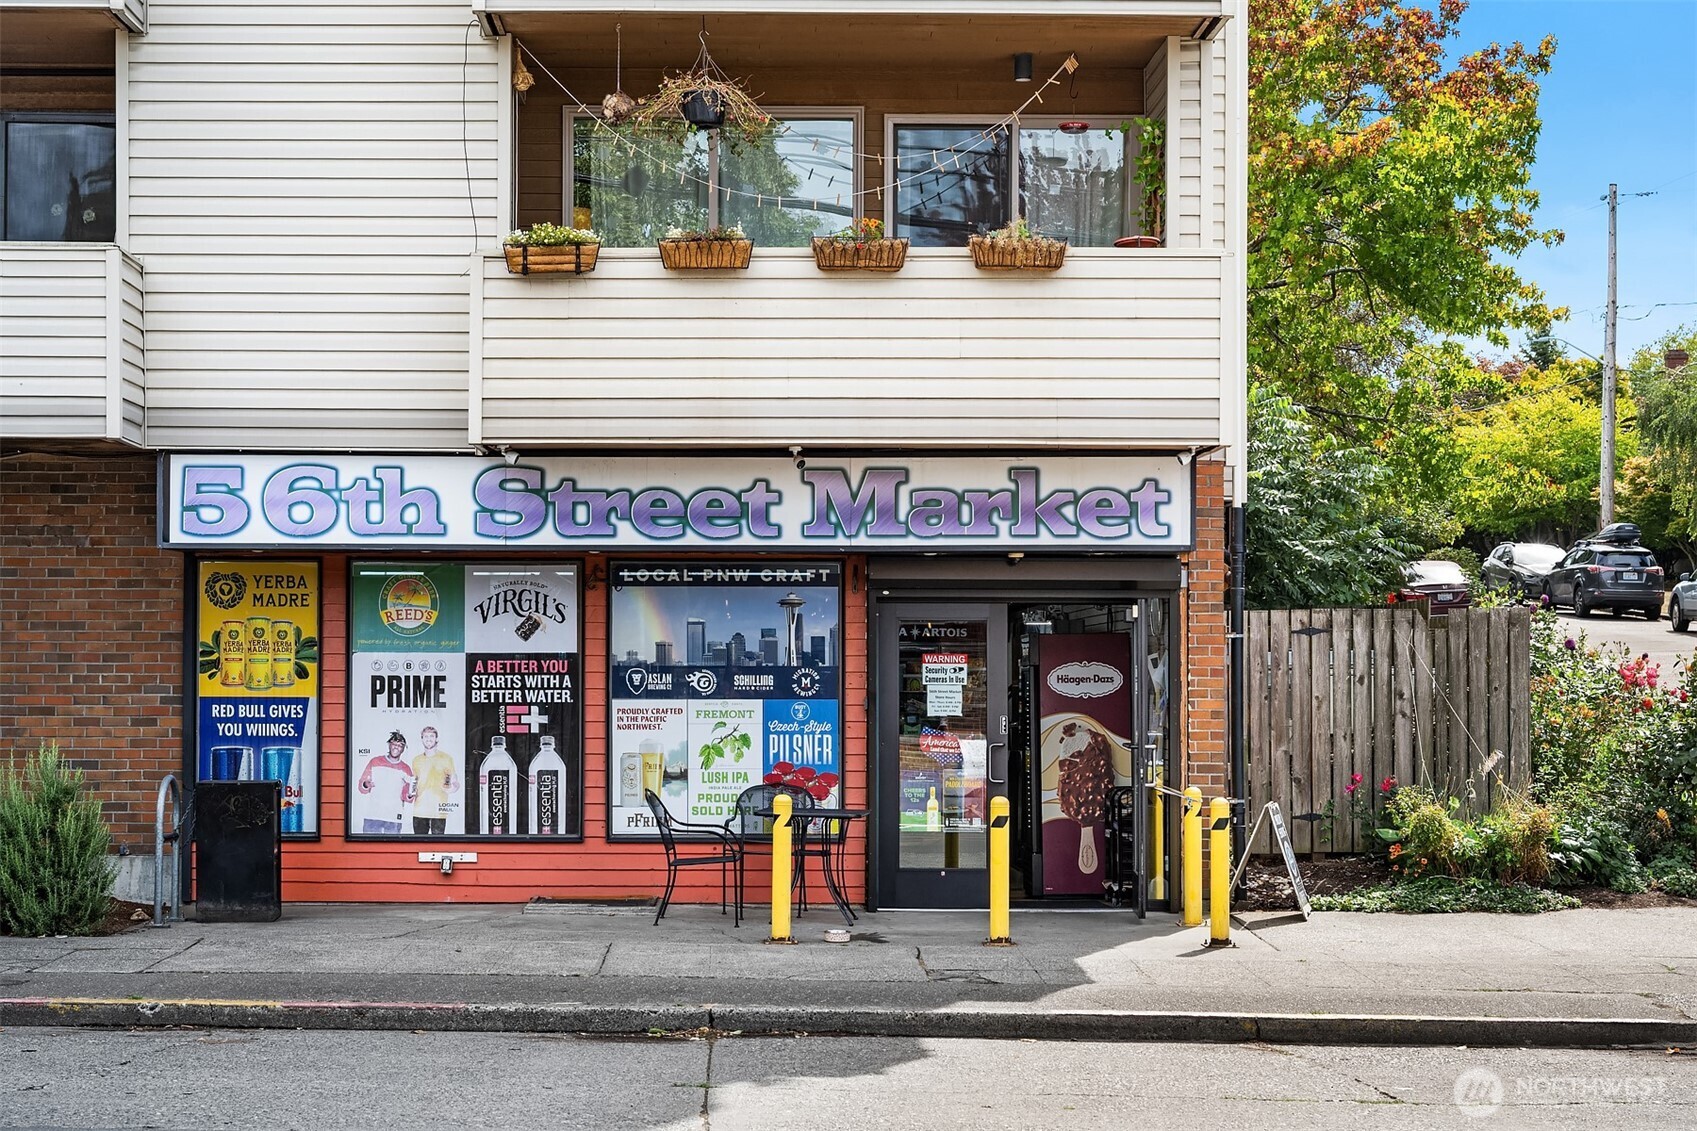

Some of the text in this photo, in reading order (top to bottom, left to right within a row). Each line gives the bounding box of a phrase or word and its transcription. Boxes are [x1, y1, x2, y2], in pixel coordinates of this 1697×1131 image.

[474, 465, 782, 538] Street
[803, 468, 1171, 538] Market
[252, 574, 308, 589] YERBA
[623, 569, 830, 582] LOCAL PNW CRAFT
[252, 593, 310, 607] MADRE
[473, 588, 567, 624] VIRGIL'S
[384, 608, 434, 623] REED'S
[921, 627, 968, 637] ARTOIS
[248, 639, 270, 647] YERBA
[924, 655, 966, 663] WARNING
[475, 660, 568, 673] A BETTER YOU
[925, 666, 948, 675] Security
[471, 674, 572, 688] STARTS WITH A
[647, 673, 672, 684] ASLAN
[733, 674, 774, 686] SCHILLING
[924, 675, 965, 683] Cameras In Use
[1056, 674, 1115, 686] Häagen-Dazs
[370, 674, 447, 709] PRIME
[471, 689, 574, 703] BETTER WATER.
[211, 704, 304, 718] RED BULL GIVES
[616, 707, 684, 715] PROUDLY CRAFTED
[695, 709, 755, 719] FREMONT
[616, 715, 668, 723] IN THE PACIFIC
[216, 723, 242, 736] YOU
[616, 723, 663, 731] NORTHWEST.
[768, 719, 833, 734] Czech-Style
[922, 735, 959, 748] America
[769, 734, 833, 765] PILSNER
[701, 771, 749, 784] LUSH IPA
[491, 775, 503, 826] essentia
[540, 775, 551, 826] essentia
[691, 805, 760, 816] SOLD HRE
